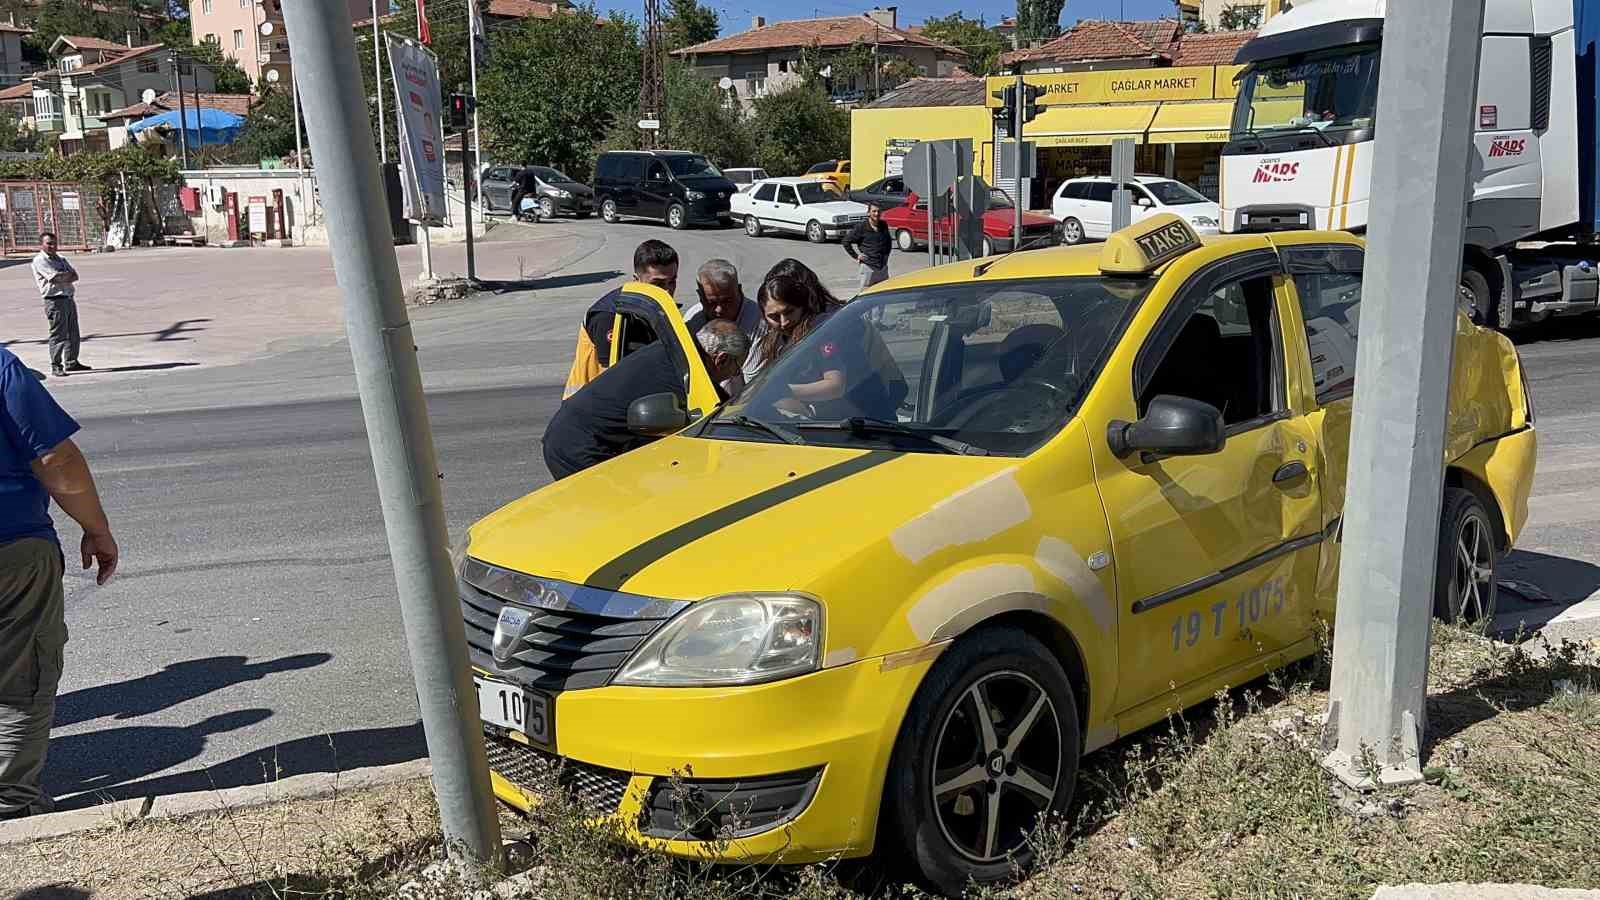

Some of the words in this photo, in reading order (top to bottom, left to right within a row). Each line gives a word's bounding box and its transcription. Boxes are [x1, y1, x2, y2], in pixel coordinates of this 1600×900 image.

[1154, 77, 1198, 89] MARKET
[1171, 608, 1200, 651] 19
[1210, 600, 1227, 637] T
[1236, 576, 1285, 625] 1075
[499, 690, 545, 735] 1075
